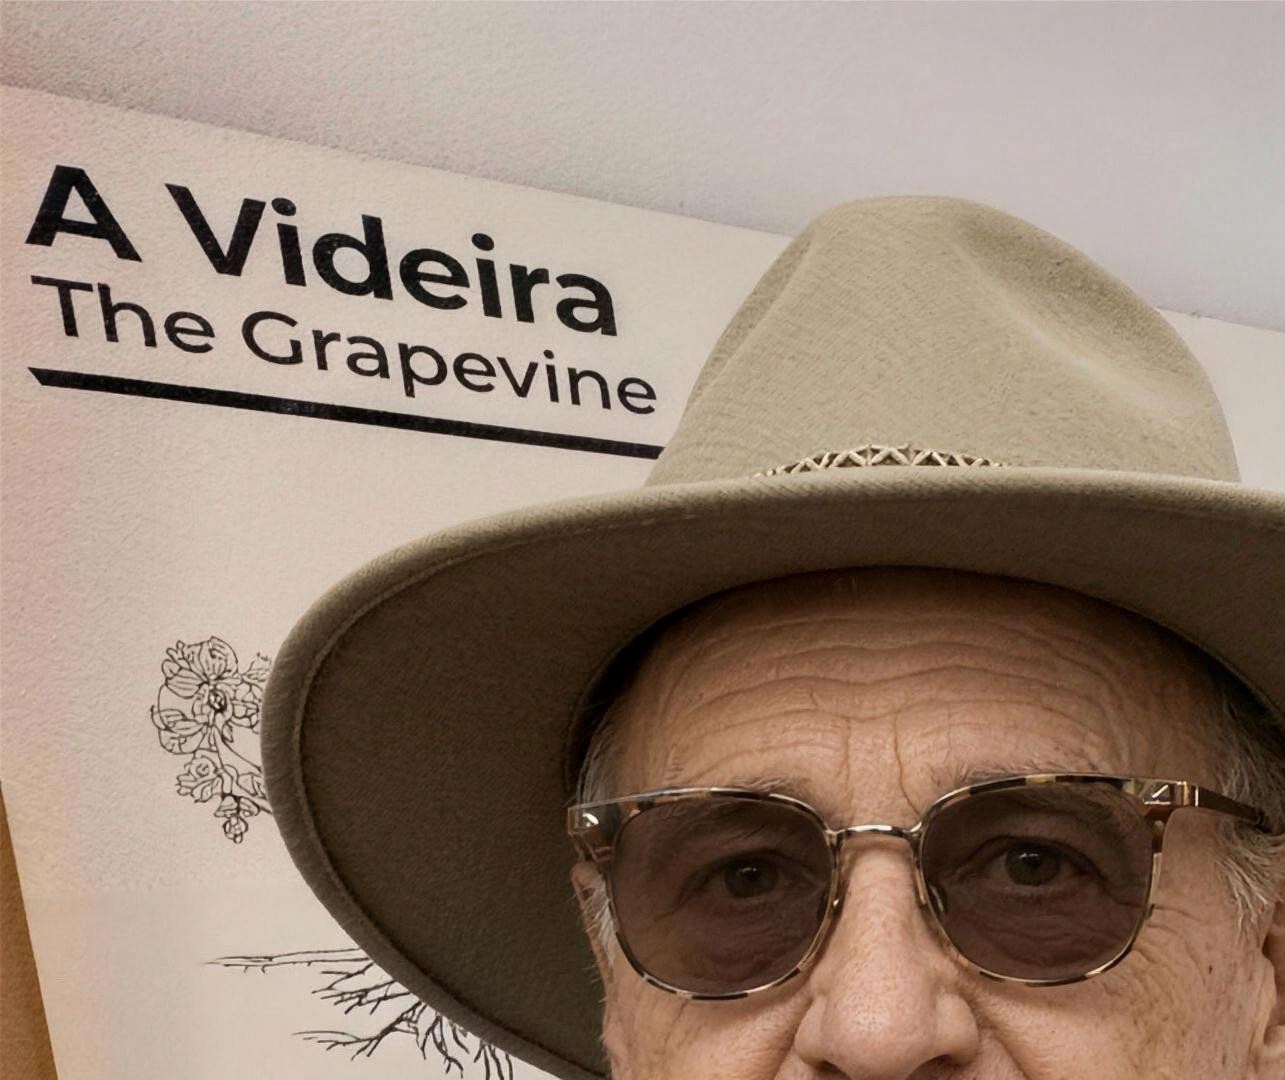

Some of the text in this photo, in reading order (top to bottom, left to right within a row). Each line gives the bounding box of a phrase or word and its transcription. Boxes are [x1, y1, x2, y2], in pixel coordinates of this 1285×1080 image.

[25, 165, 618, 337] A Videira
[30, 275, 657, 415] The Grapevine
